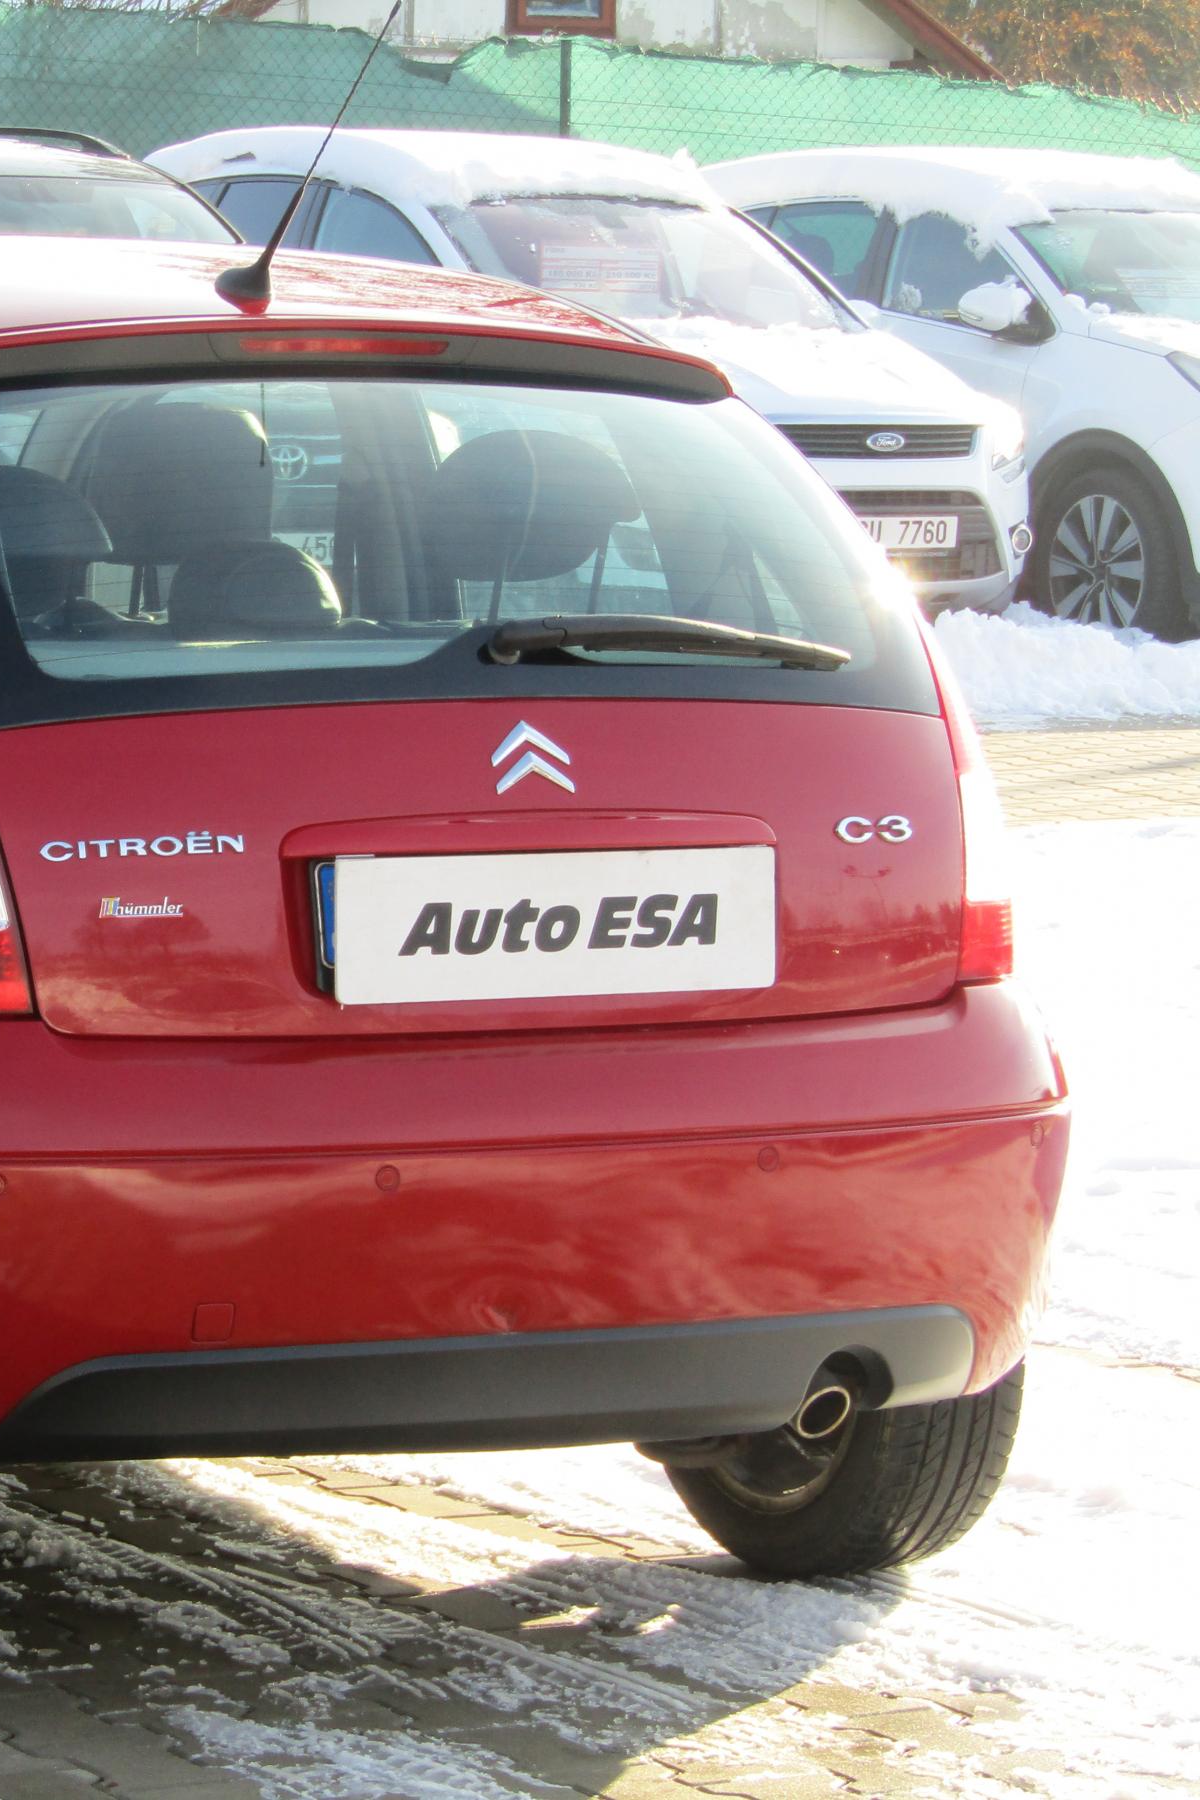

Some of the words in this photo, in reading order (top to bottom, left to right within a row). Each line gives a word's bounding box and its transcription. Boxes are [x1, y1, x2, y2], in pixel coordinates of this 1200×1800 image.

[898, 520, 947, 545] 7760
[835, 815, 913, 844] C3
[39, 831, 245, 862] CITROËN
[398, 899, 581, 956] Auto
[587, 893, 719, 950] ESA
